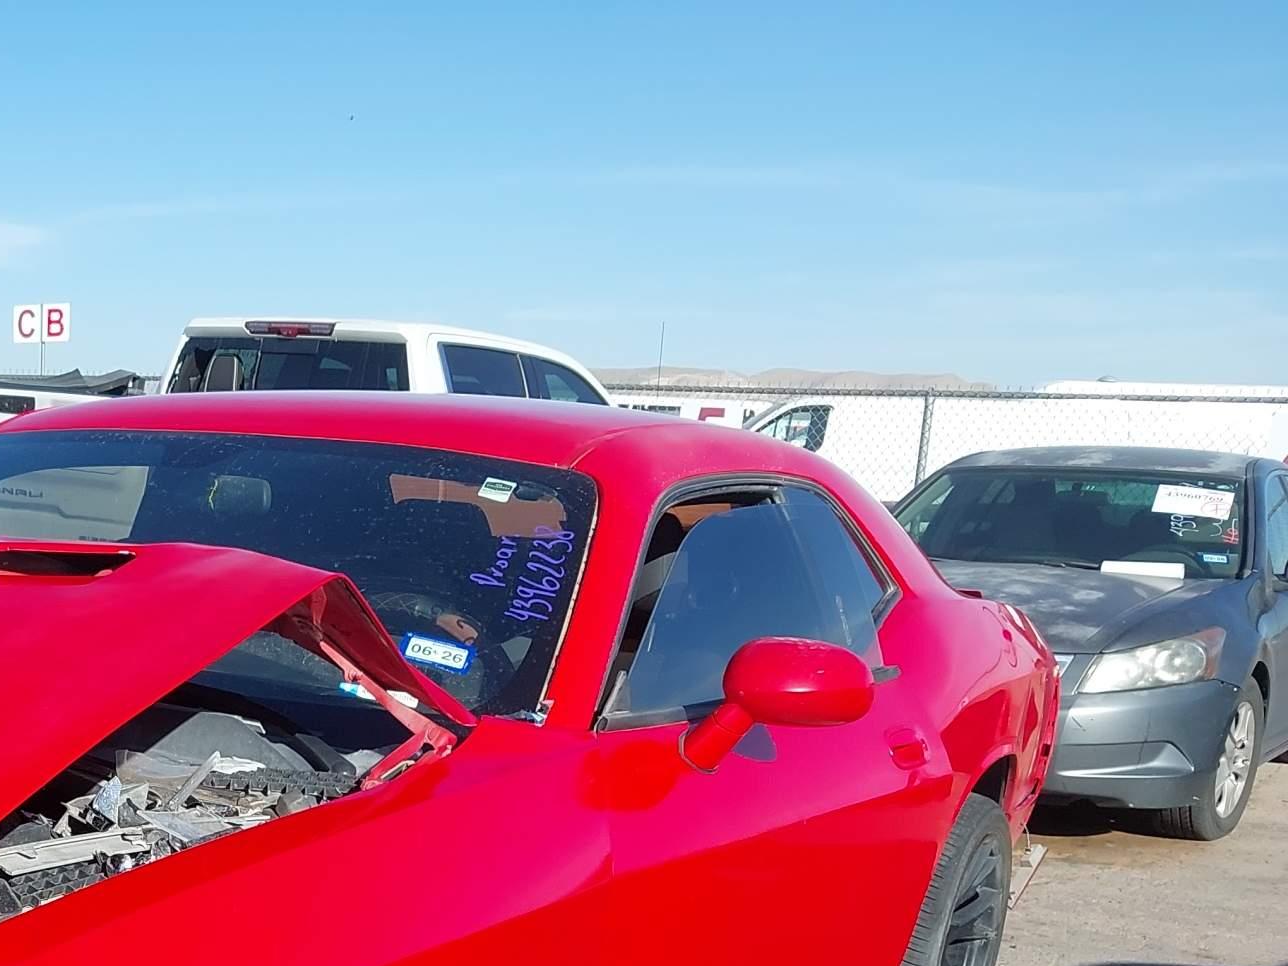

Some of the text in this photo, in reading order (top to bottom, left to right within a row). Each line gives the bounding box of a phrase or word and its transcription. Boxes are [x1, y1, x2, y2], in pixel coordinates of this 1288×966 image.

[18, 308, 64, 339] C B
[503, 525, 575, 621] 43962238
